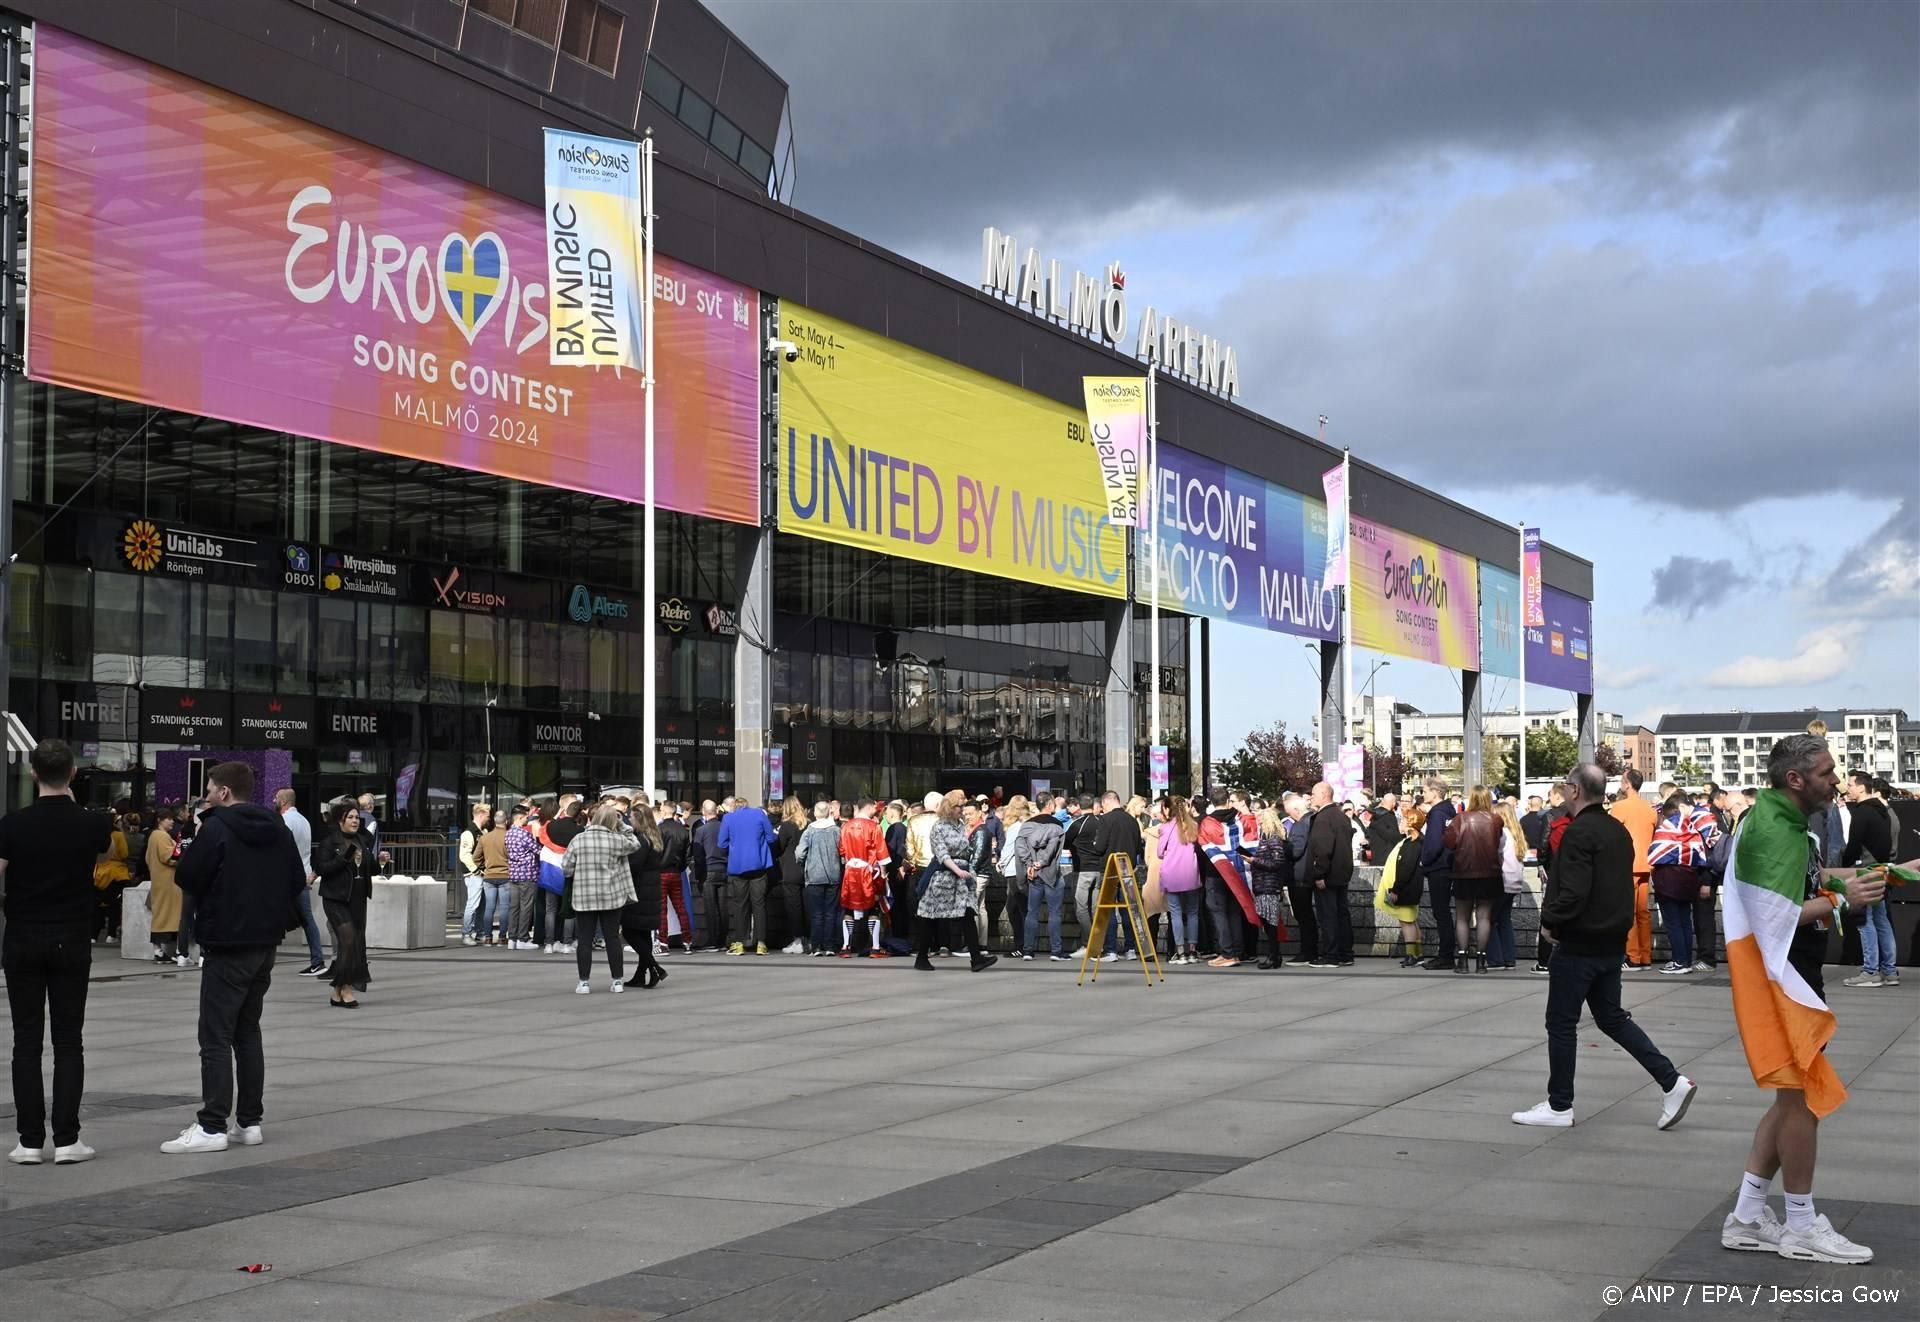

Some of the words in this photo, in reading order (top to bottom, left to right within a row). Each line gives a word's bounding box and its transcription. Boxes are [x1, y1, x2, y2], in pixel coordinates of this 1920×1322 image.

[653, 272, 686, 306] EBU
[697, 290, 723, 319] svt
[789, 319, 805, 341] Sat,
[807, 326, 826, 350] May
[807, 347, 826, 370] May
[828, 354, 835, 370] 11
[1138, 305, 1240, 397] ARENA
[353, 335, 438, 383] SONG
[450, 361, 573, 417] CONTEST
[395, 391, 480, 433] MALMÖ
[488, 415, 539, 446] 2024
[1067, 421, 1085, 443] EBU
[788, 427, 944, 546] UNITED
[957, 475, 1000, 559] BY
[1012, 490, 1120, 585] MUSIC
[167, 533, 223, 557] Unilabs
[167, 561, 203, 576] Röntgen
[344, 555, 397, 575] Myresjöhus
[285, 571, 315, 587] OBOS
[344, 576, 397, 596] SmålandsVillan
[1209, 553, 1238, 611] TO
[592, 596, 629, 618] Aleris
[660, 602, 691, 621] Retro
[1396, 609, 1412, 626] SONG
[1413, 614, 1438, 632] CONTEST
[151, 715, 190, 726] STANDING
[191, 716, 223, 727] SECTION
[181, 727, 194, 737] A/B
[241, 718, 277, 729] STANDING
[278, 719, 308, 730] SECTION
[265, 730, 285, 740] C/D/E
[536, 725, 582, 742] KONTOR
